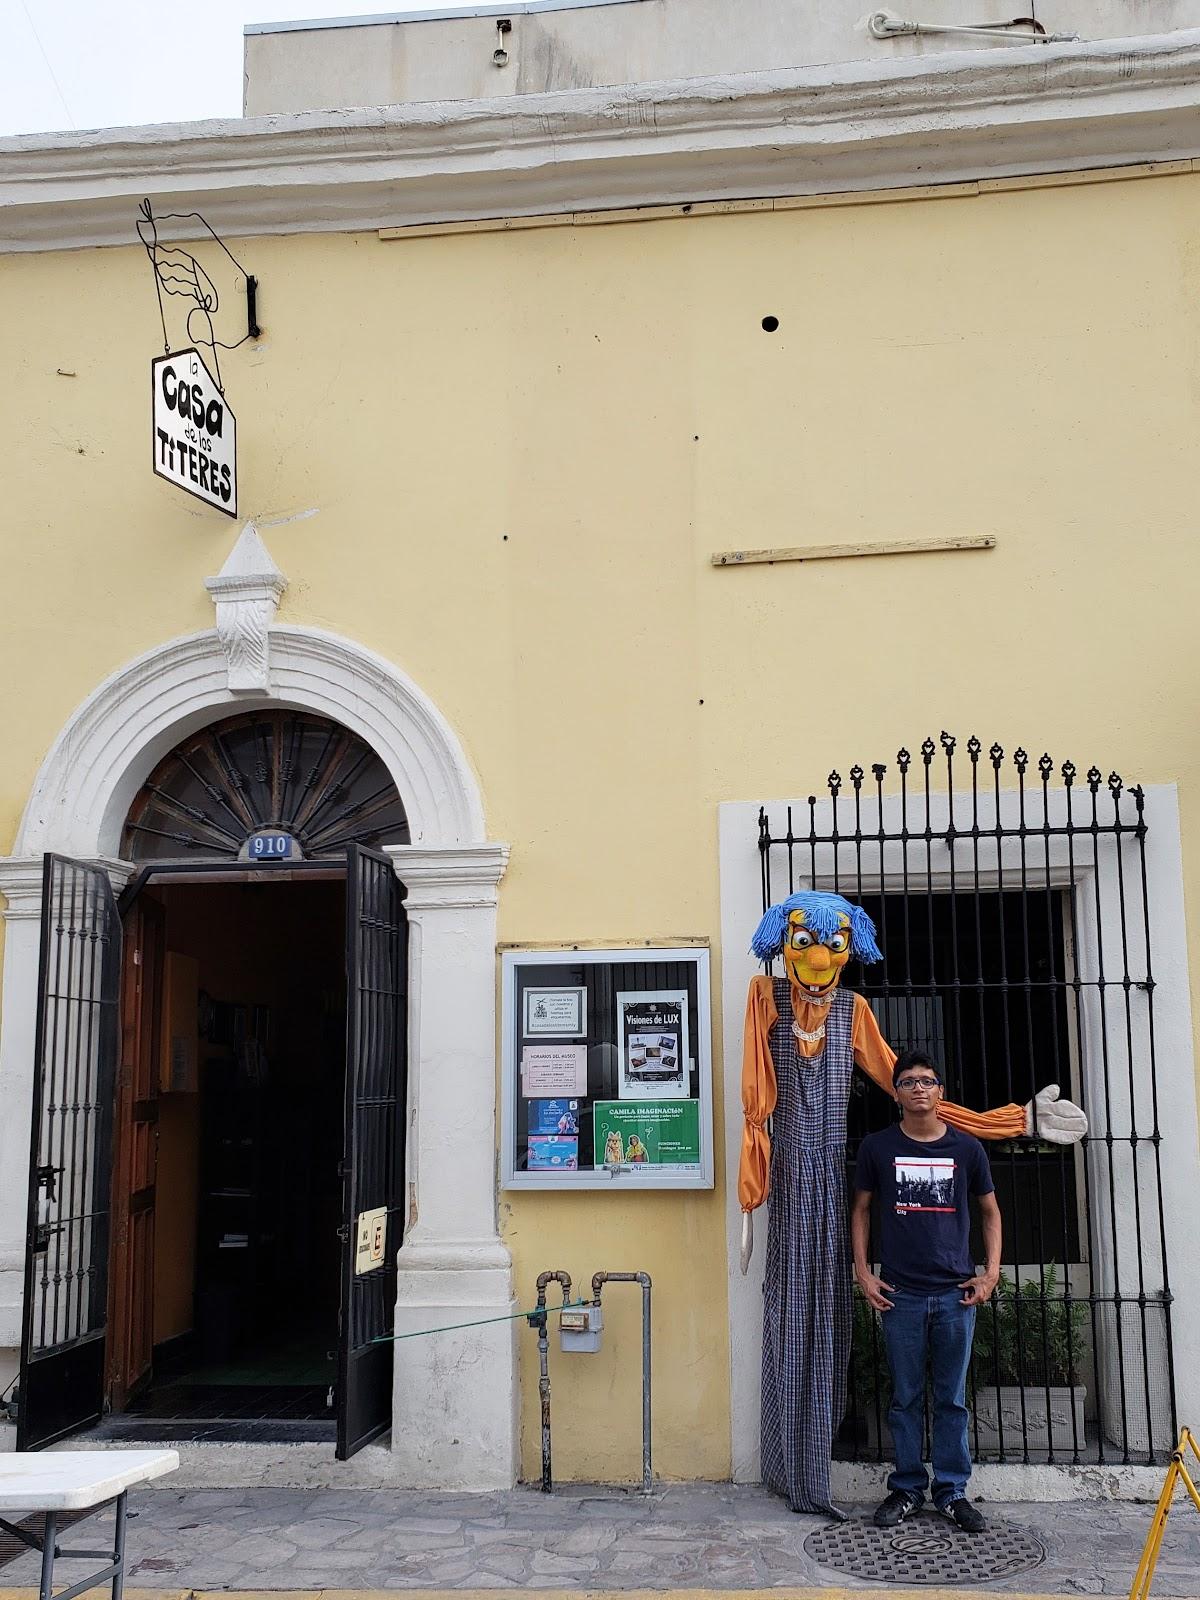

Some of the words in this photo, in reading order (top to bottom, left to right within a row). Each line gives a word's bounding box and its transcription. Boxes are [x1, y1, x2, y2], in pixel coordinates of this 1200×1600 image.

[189, 355, 198, 377] la
[162, 365, 223, 439] Casa
[184, 422, 198, 443] de
[198, 429, 212, 452] los
[254, 836, 287, 854] 910
[626, 1014, 653, 1025] Visiones
[654, 1014, 663, 1024] de
[663, 1013, 680, 1024] LUX
